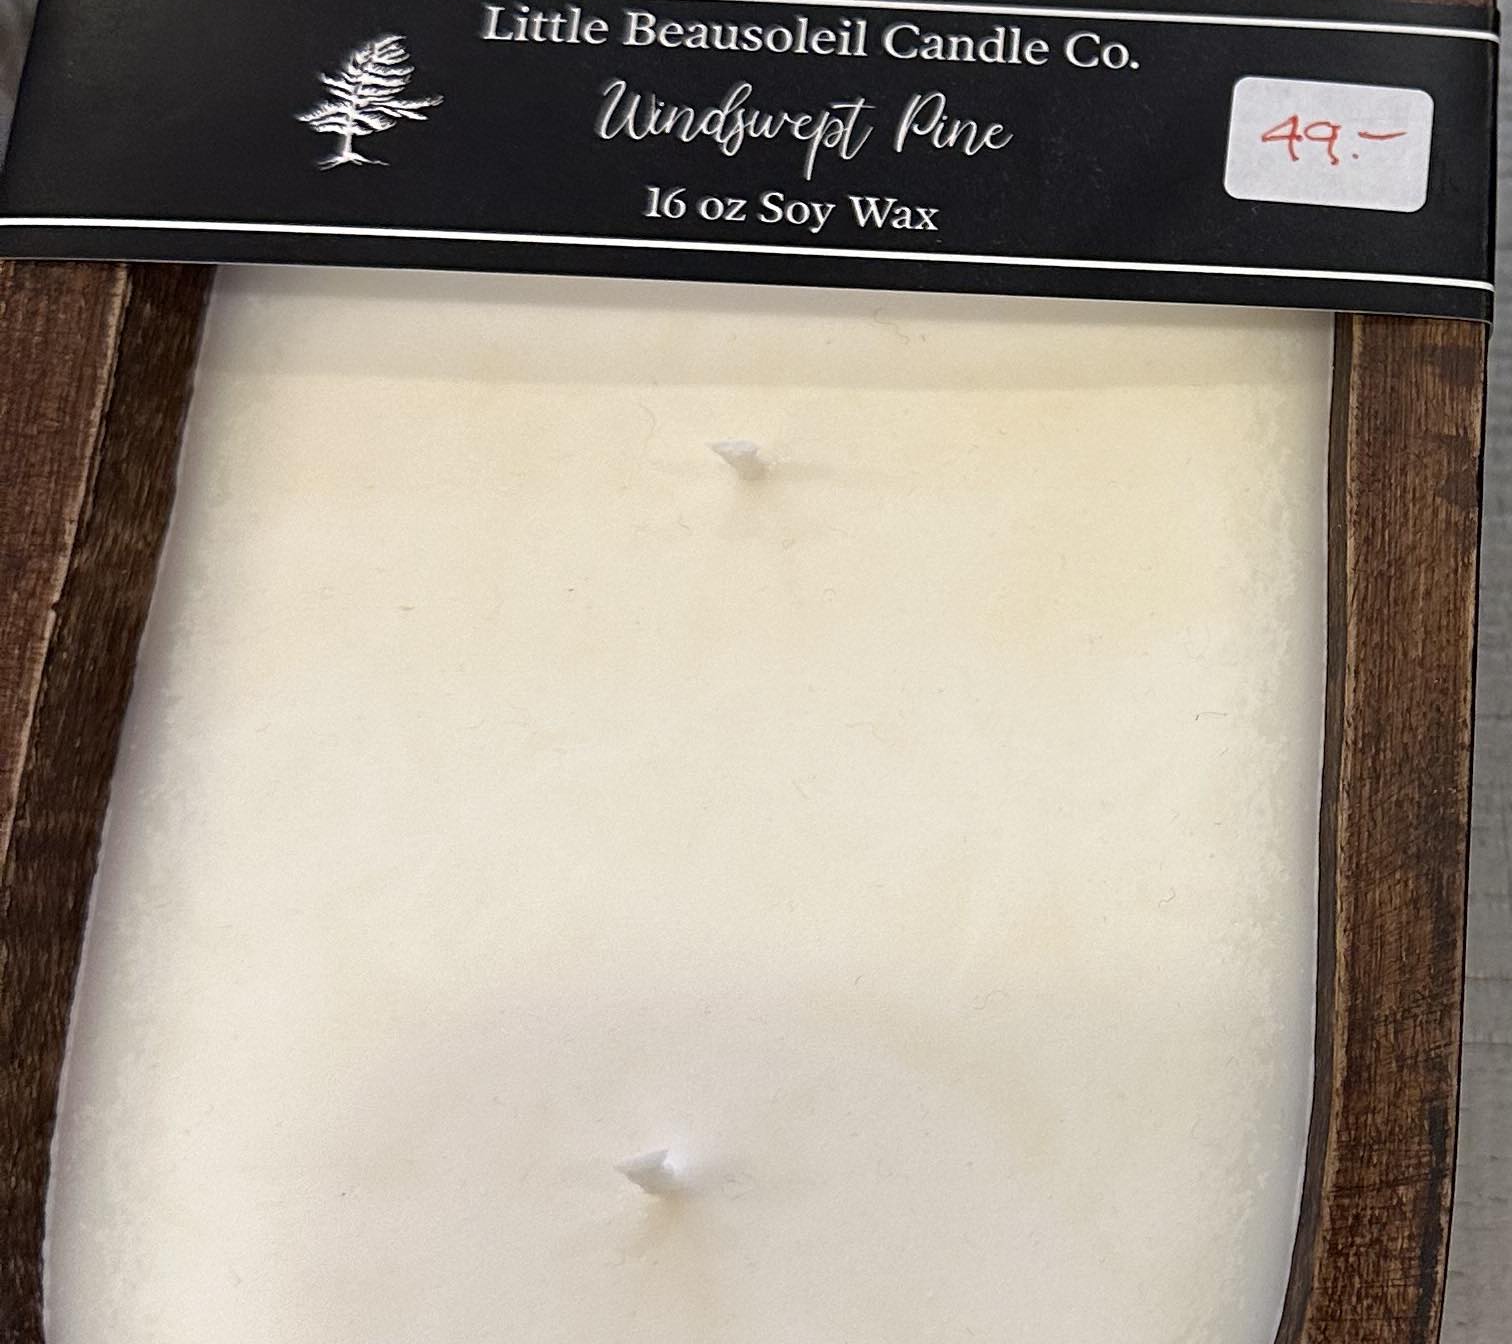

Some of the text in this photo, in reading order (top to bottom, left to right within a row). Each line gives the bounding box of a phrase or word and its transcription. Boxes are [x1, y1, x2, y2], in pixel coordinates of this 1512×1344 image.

[482, 5, 1141, 70] Little Beausoleil Candle Co.
[598, 79, 1014, 181] Windswept Pine
[645, 186, 940, 234] 16 oz Soy Wax
